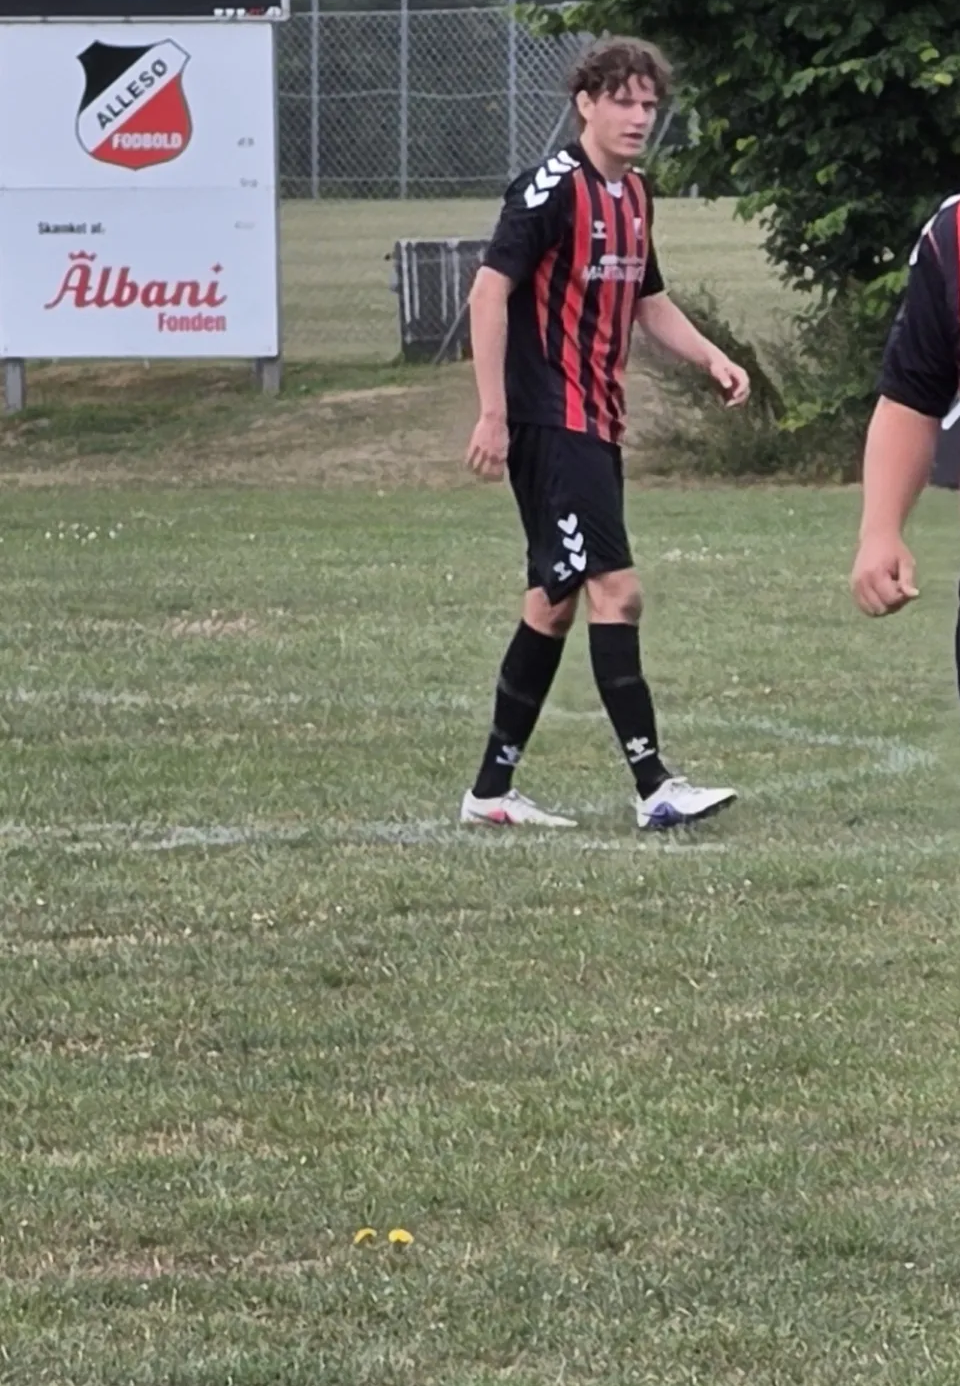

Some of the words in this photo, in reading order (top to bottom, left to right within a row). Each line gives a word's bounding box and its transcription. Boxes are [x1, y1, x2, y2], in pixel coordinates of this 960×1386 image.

[112, 132, 183, 150] FODBOLD
[43, 262, 228, 310] Albani
[158, 312, 227, 332] Fonden
